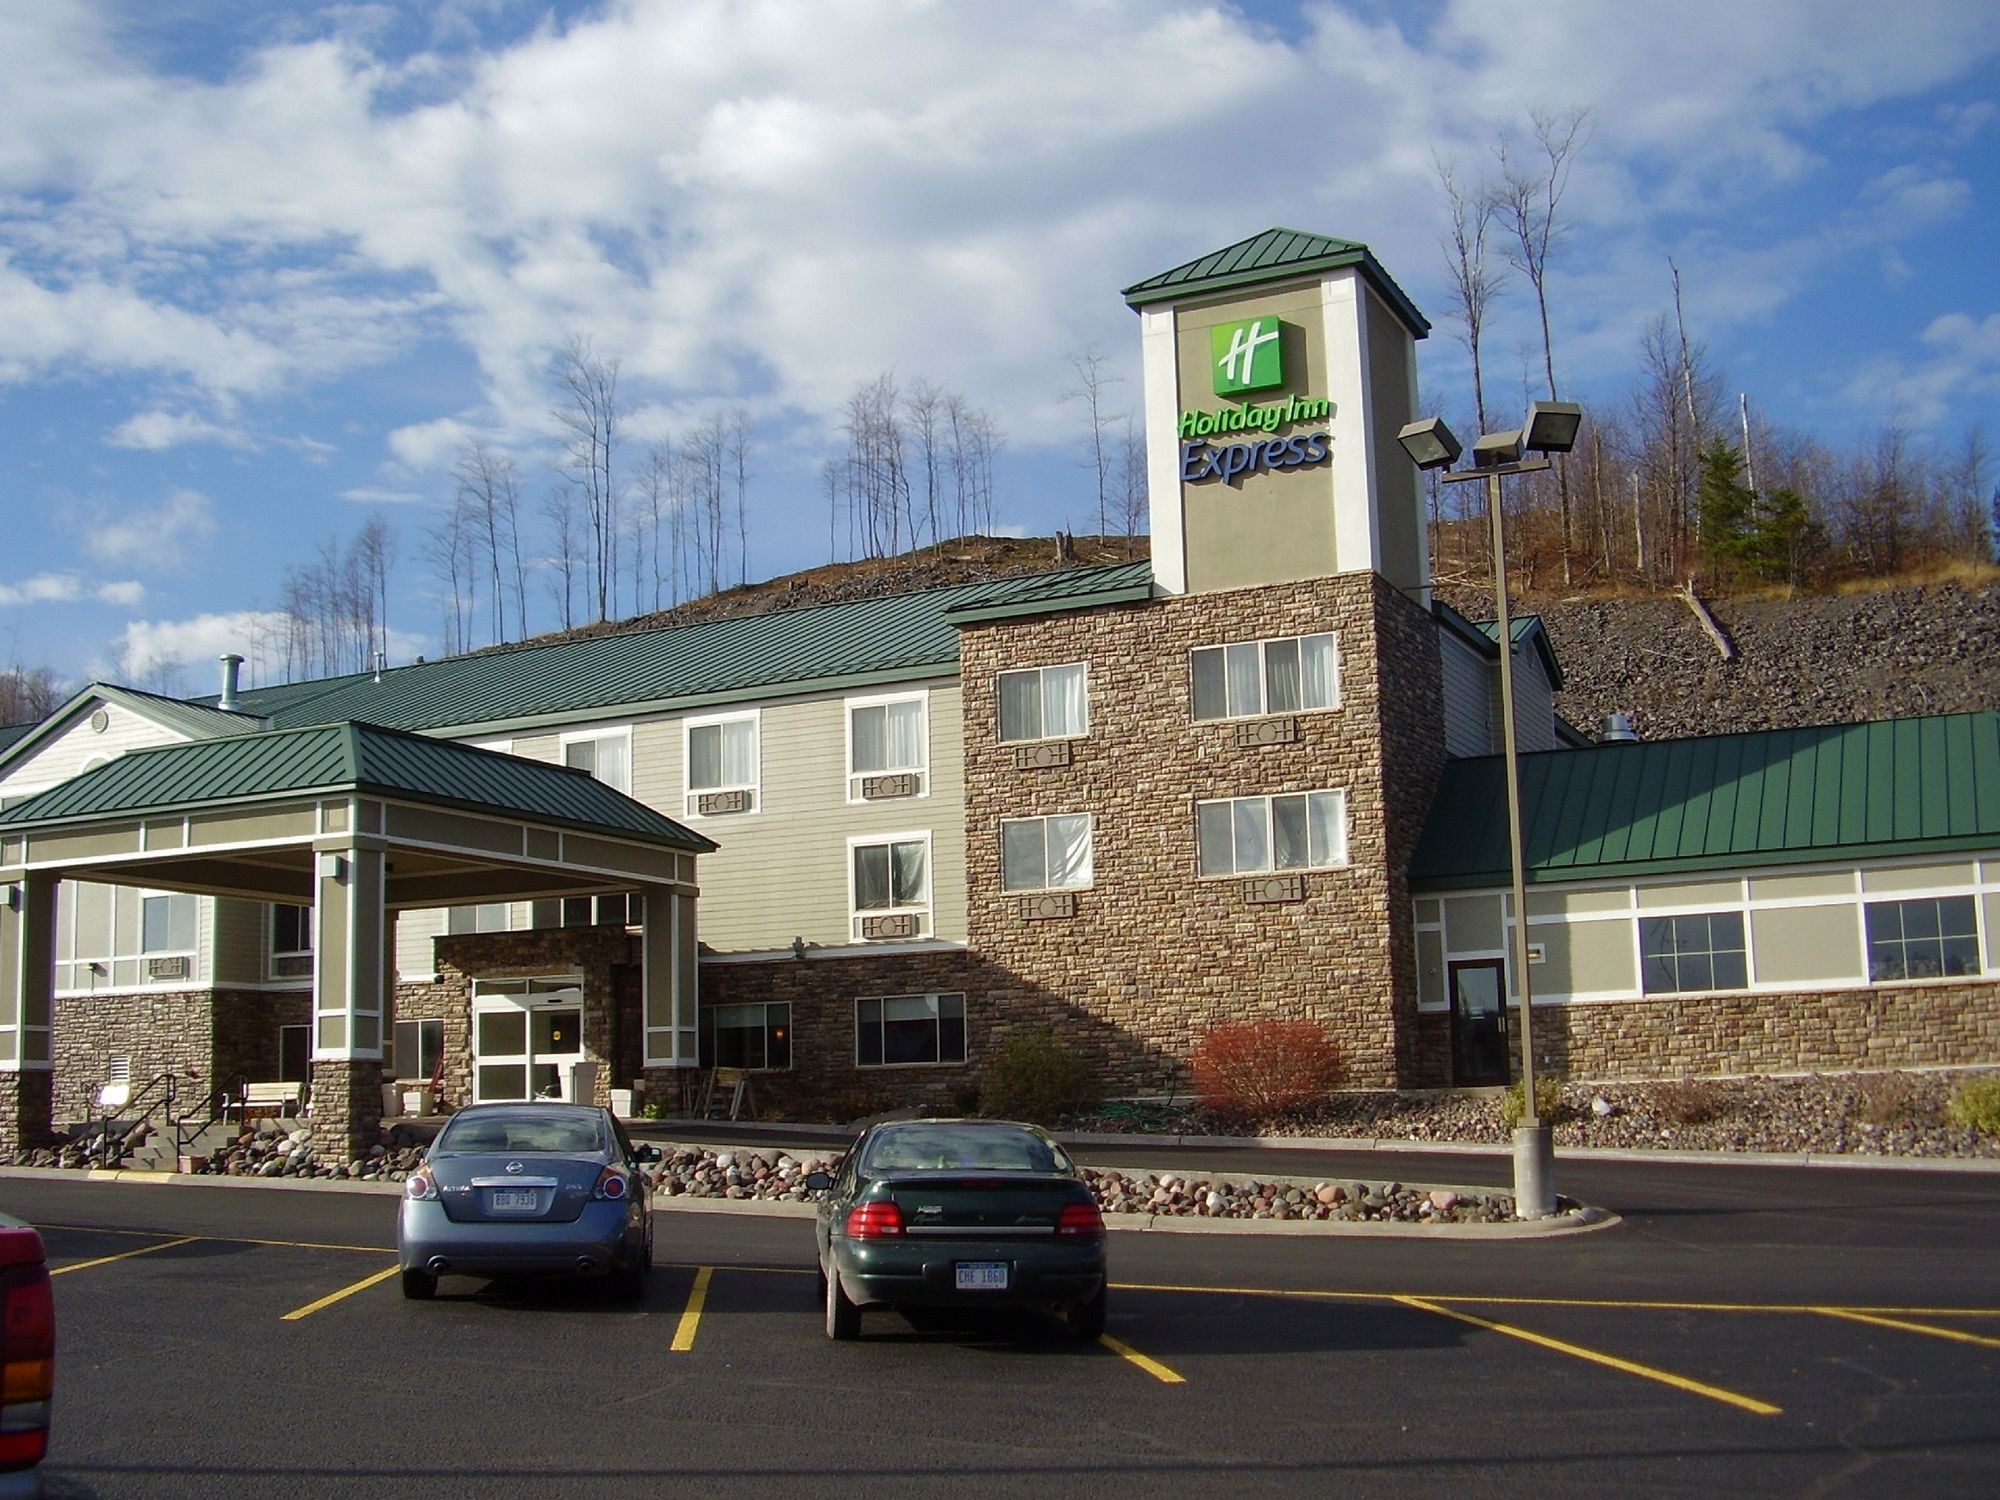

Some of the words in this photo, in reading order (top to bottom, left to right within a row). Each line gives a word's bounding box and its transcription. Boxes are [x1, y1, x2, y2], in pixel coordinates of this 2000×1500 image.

[1177, 401, 1282, 438] Holiday
[1285, 392, 1329, 422] Inn
[1180, 431, 1328, 485] Express
